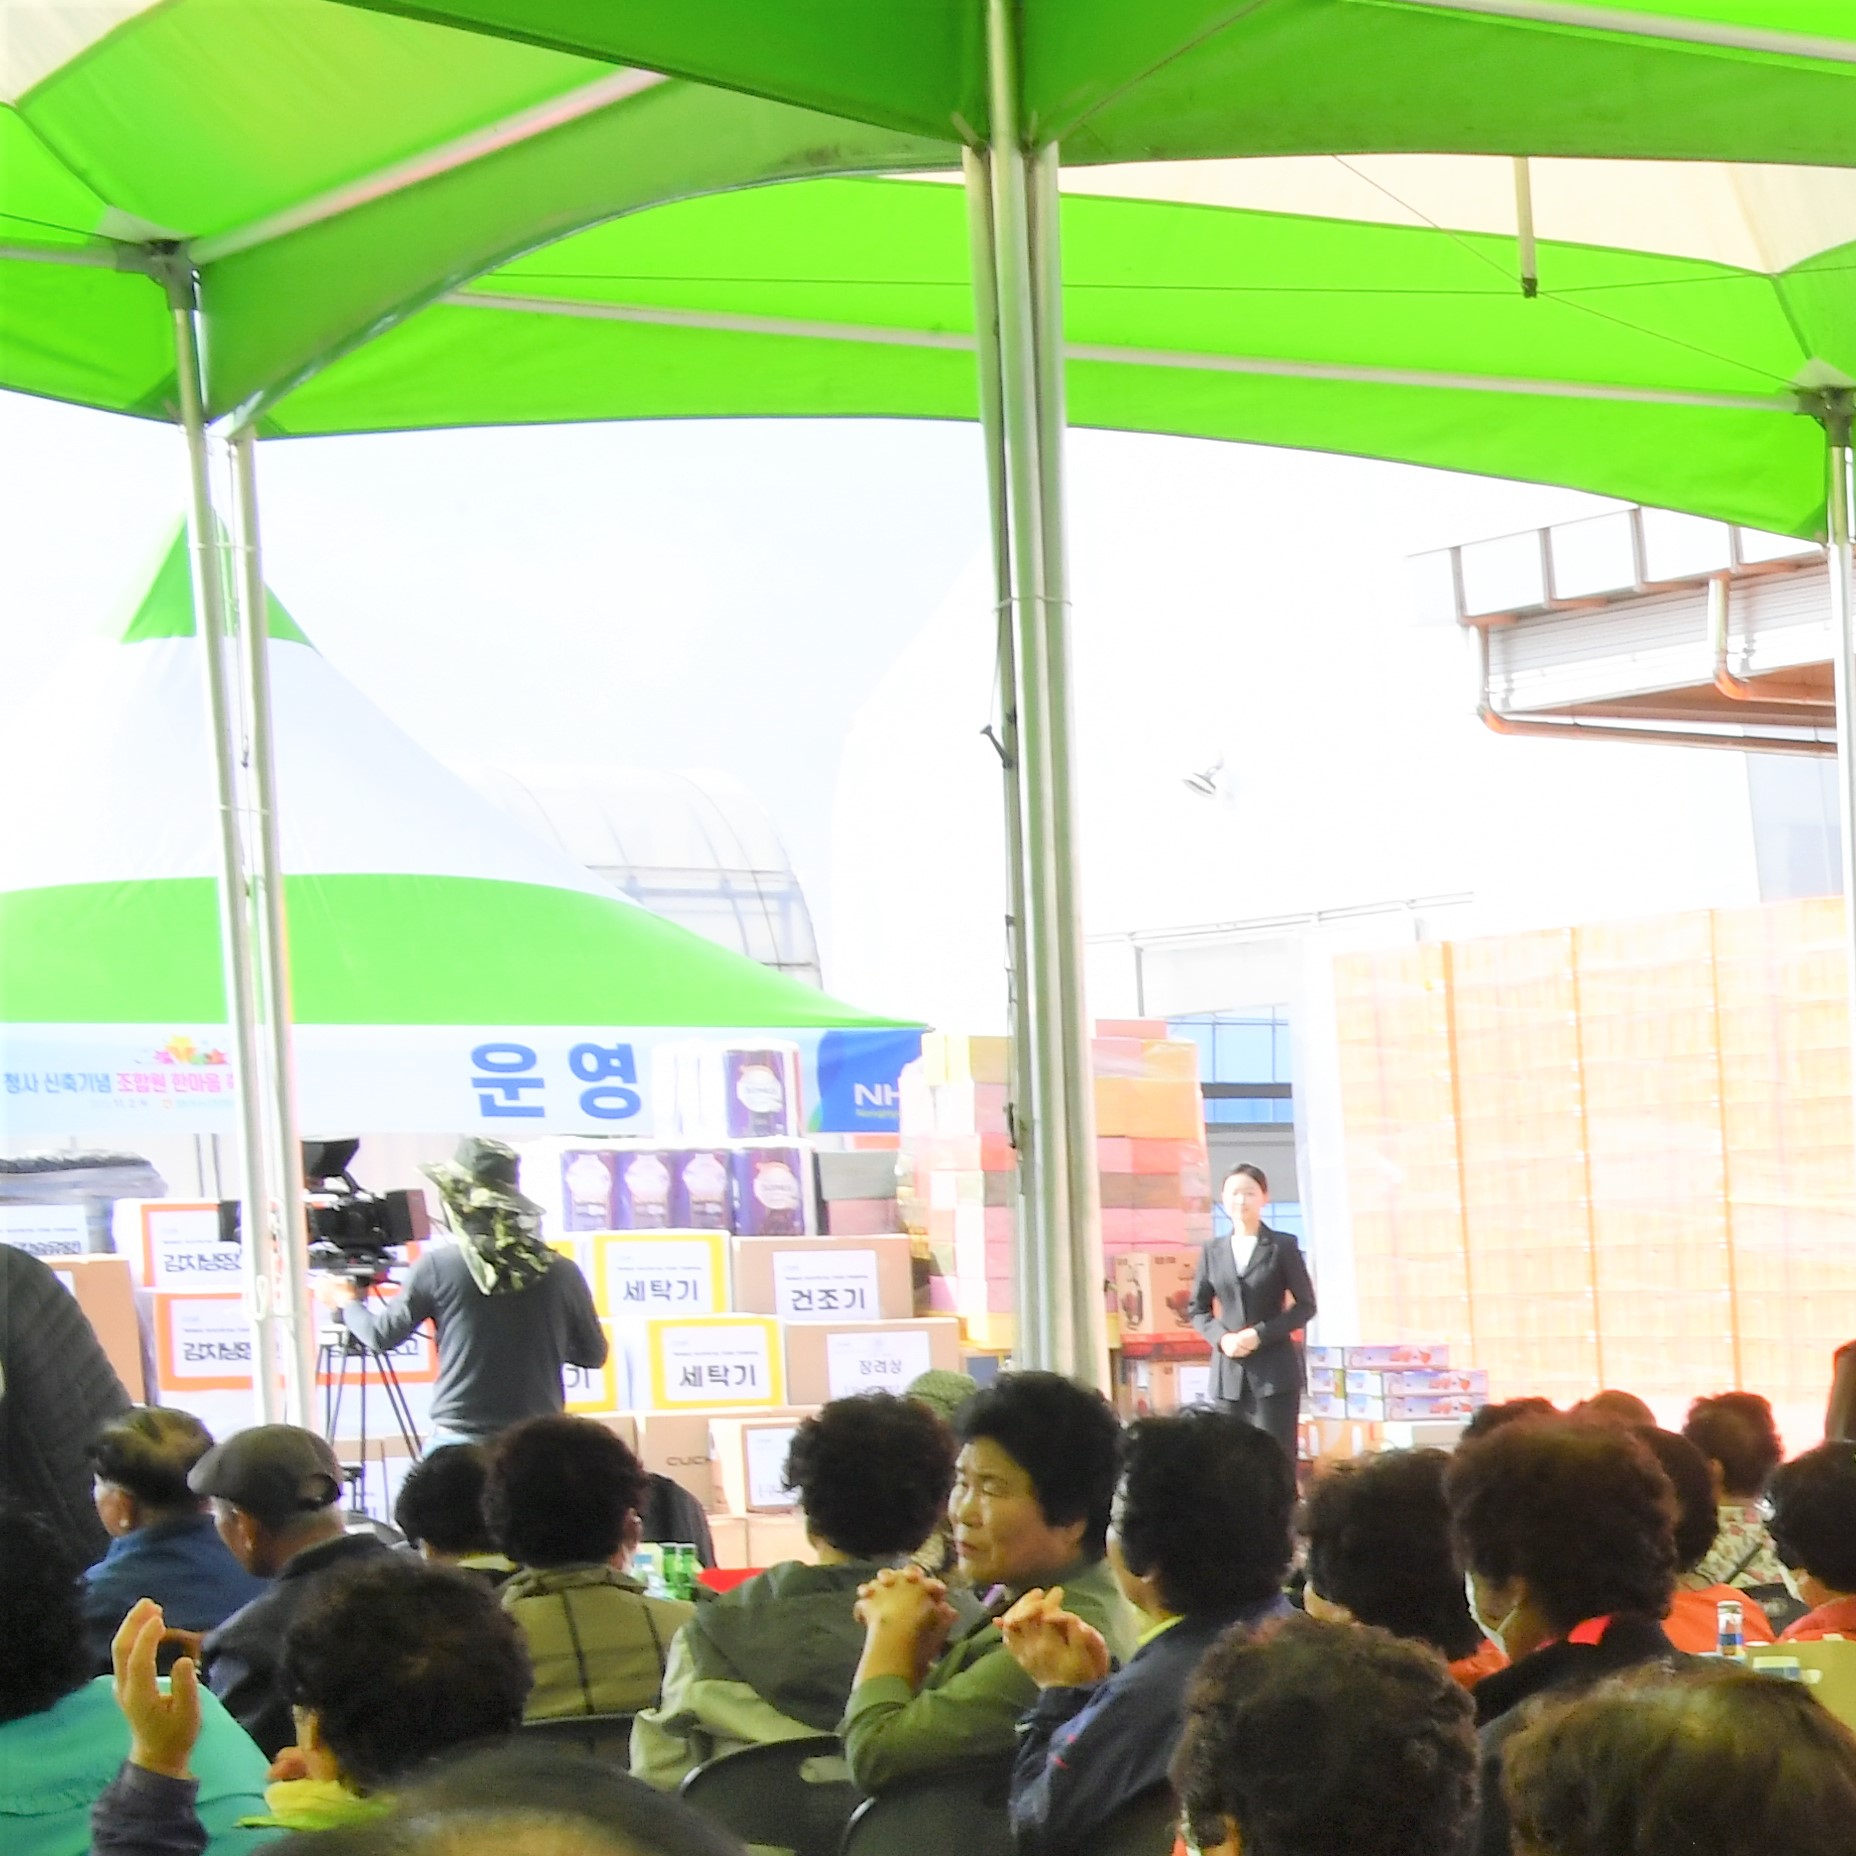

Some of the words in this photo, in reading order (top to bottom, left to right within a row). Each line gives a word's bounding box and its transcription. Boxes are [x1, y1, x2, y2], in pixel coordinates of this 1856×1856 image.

[44, 1072, 112, 1094] 신축기념
[116, 1072, 167, 1093] 조합원
[171, 1072, 222, 1093] 한마음
[470, 1042, 642, 1120] 운영
[163, 1252, 242, 1273] 김치냉장
[622, 1279, 700, 1302] 세탁기
[791, 1287, 866, 1311] 건조기
[679, 1364, 758, 1388] 세탁기
